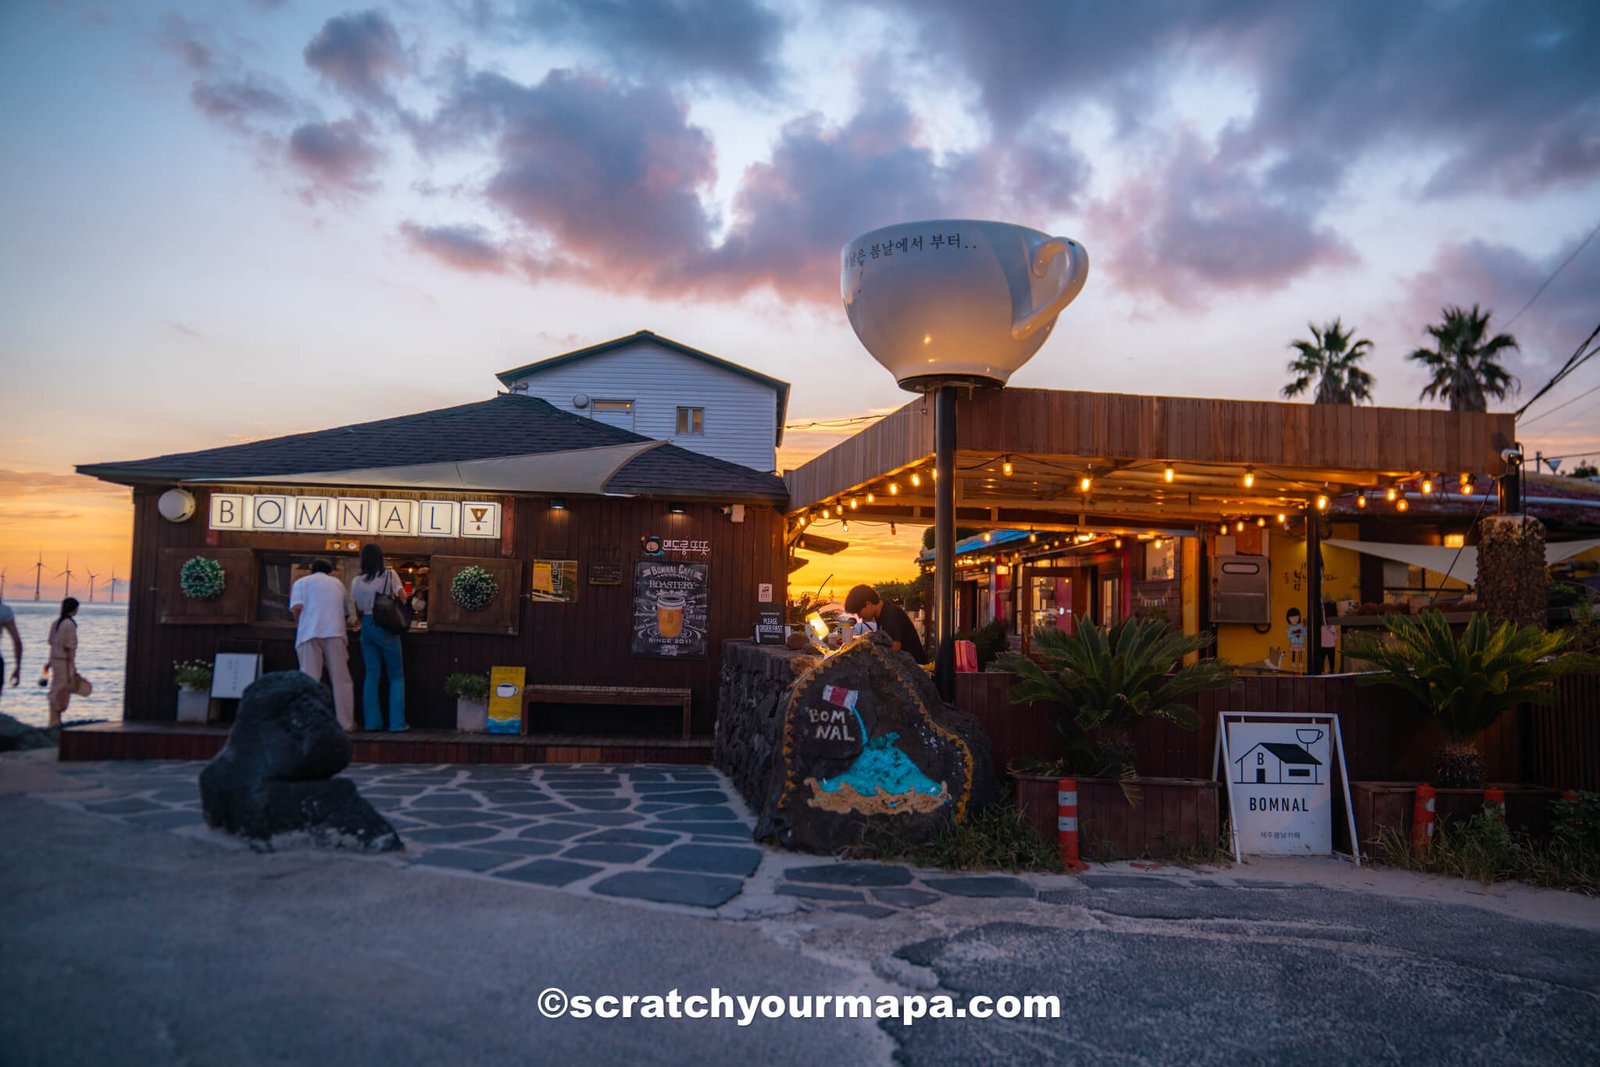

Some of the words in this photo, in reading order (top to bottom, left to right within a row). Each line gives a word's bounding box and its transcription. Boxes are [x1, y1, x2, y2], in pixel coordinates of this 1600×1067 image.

[870, 235, 923, 260] 봄날에서
[219, 499, 442, 531] BOMNAL
[649, 580, 695, 590] ROASTERY
[763, 617, 778, 625] PLEASE
[815, 724, 856, 741] NAL
[1257, 752, 1264, 765] B
[1249, 797, 1309, 812] BOMNAL
